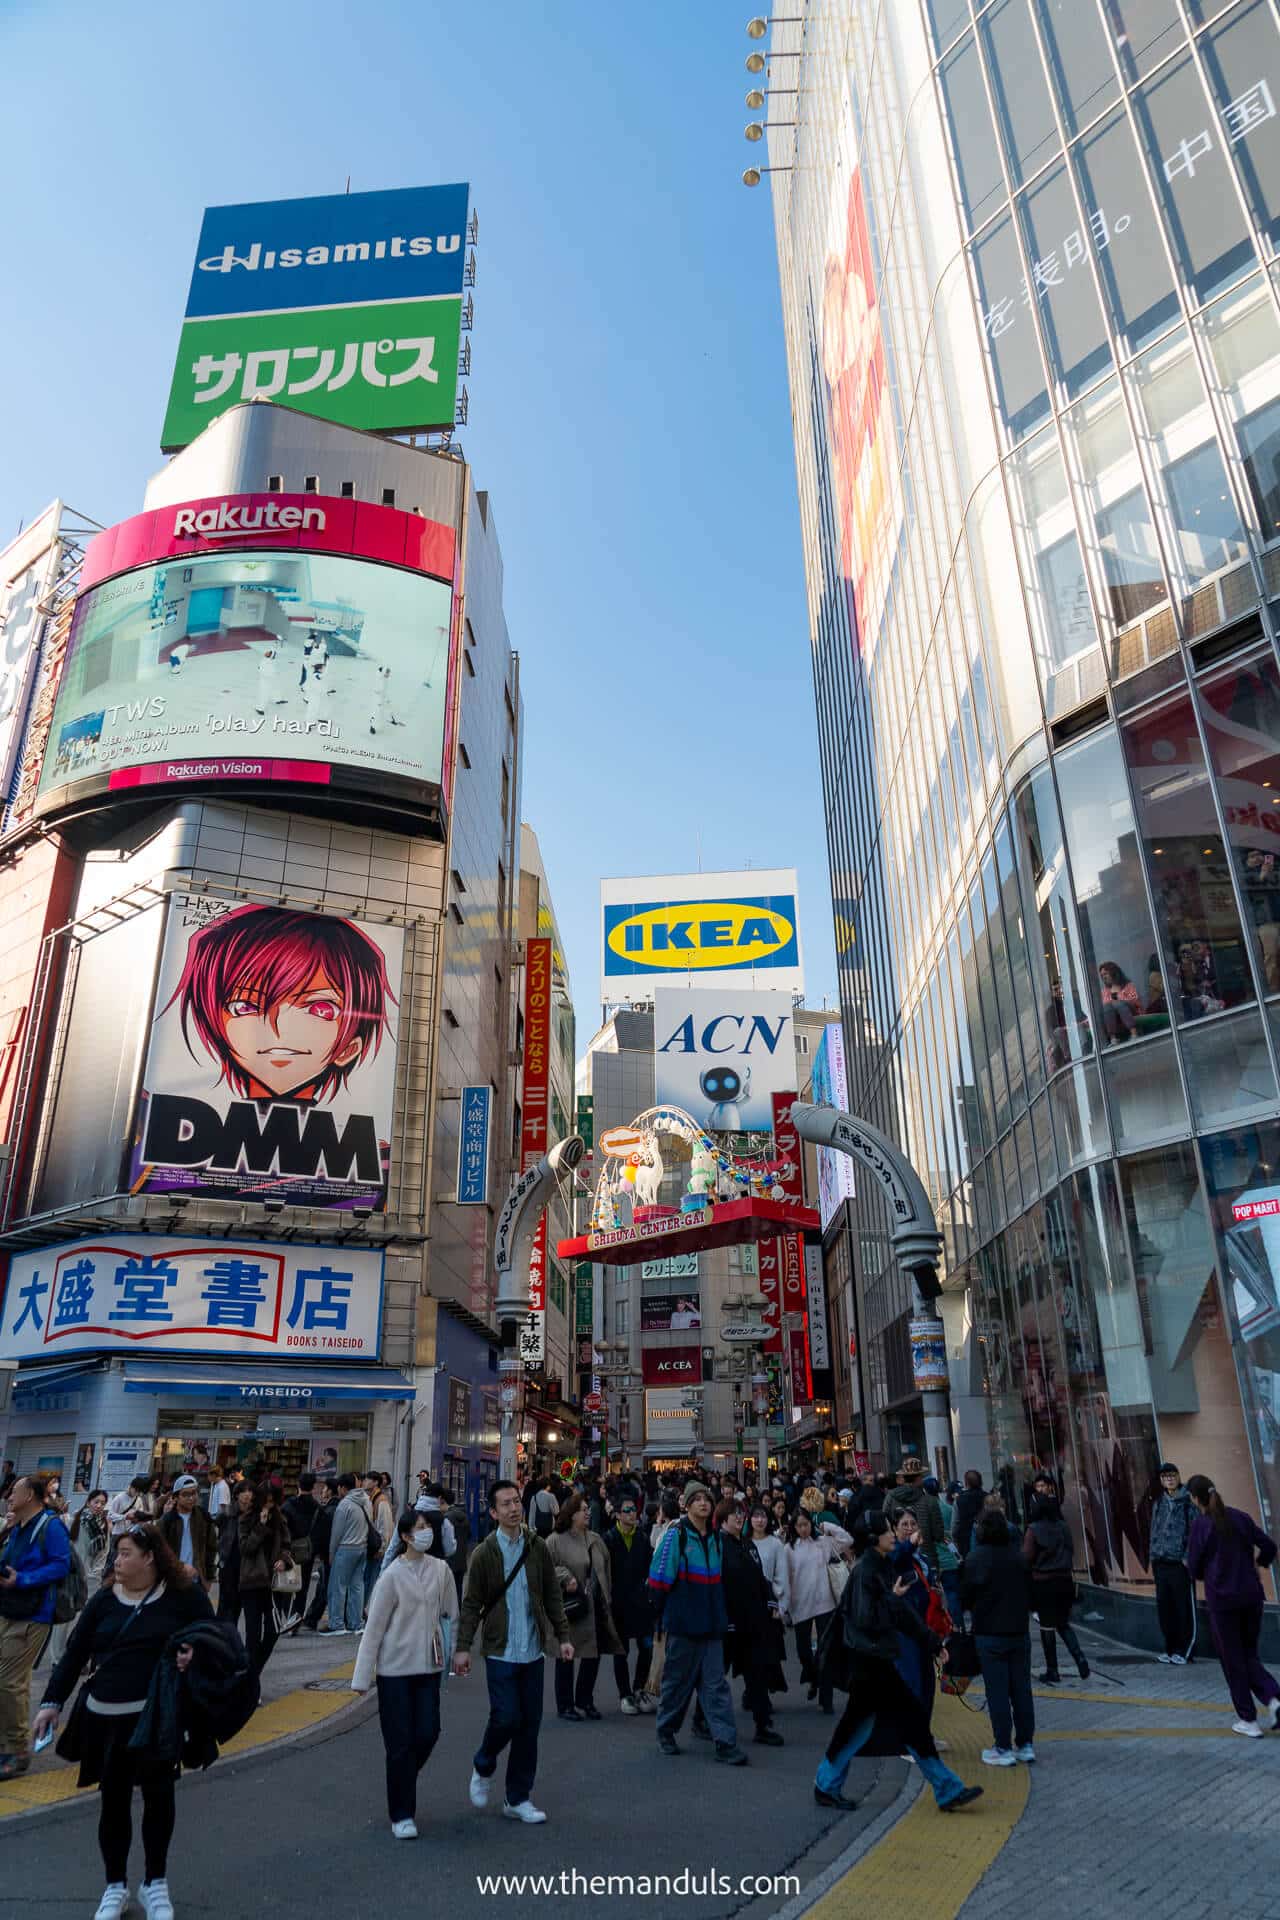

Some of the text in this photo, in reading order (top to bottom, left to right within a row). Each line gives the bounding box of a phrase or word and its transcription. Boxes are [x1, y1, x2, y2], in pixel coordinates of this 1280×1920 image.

[1163, 80, 1276, 183] 中国
[199, 234, 461, 272] Hisamitsu
[192, 336, 439, 403] サロンパス
[173, 501, 326, 538] Rakuten
[107, 696, 168, 727] TWS
[129, 740, 169, 759] NOW!
[167, 762, 262, 778] Rakuten Vision
[625, 918, 781, 953] IKEA
[529, 944, 546, 1074] クスリのことなら
[658, 1014, 790, 1055] ACN
[142, 1093, 382, 1183] DMM
[464, 1092, 484, 1197] 大盛堂商事ビル
[839, 1124, 907, 1216] 渋谷センター街
[594, 1210, 705, 1247] SHIBUYA CENTER-GAI
[1234, 1201, 1277, 1220] POP MART
[644, 1262, 697, 1276] クリニック
[13, 1256, 353, 1336] 大盛堂書店
[287, 1335, 363, 1349] BOOKS TAISEIDO
[240, 1386, 312, 1397] TAISEIDO
